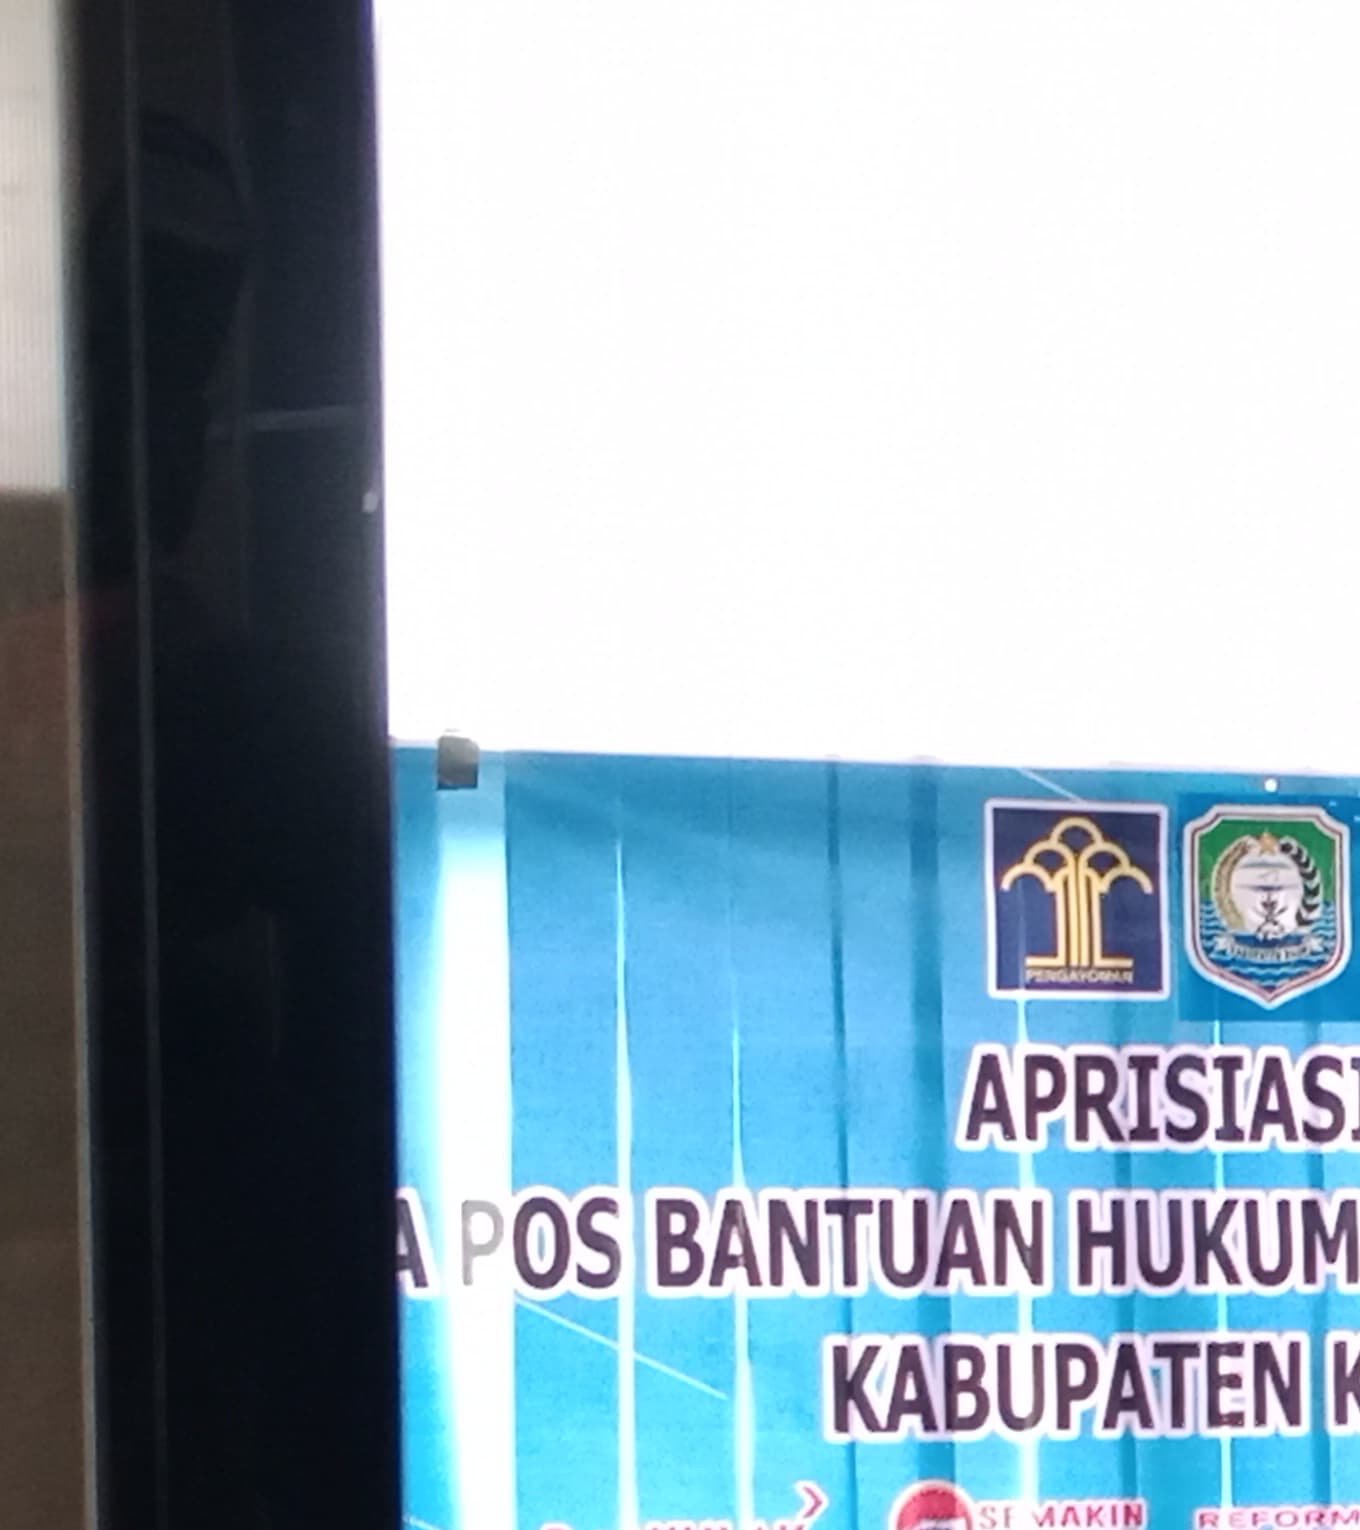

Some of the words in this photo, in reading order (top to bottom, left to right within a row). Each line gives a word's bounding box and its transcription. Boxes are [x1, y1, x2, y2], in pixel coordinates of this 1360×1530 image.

[460, 1196, 623, 1290] POS
[655, 1197, 1044, 1288] BANTUAN
[1076, 1196, 1360, 1287] HUKUM
[832, 1340, 1302, 1432] KABUPATEN
